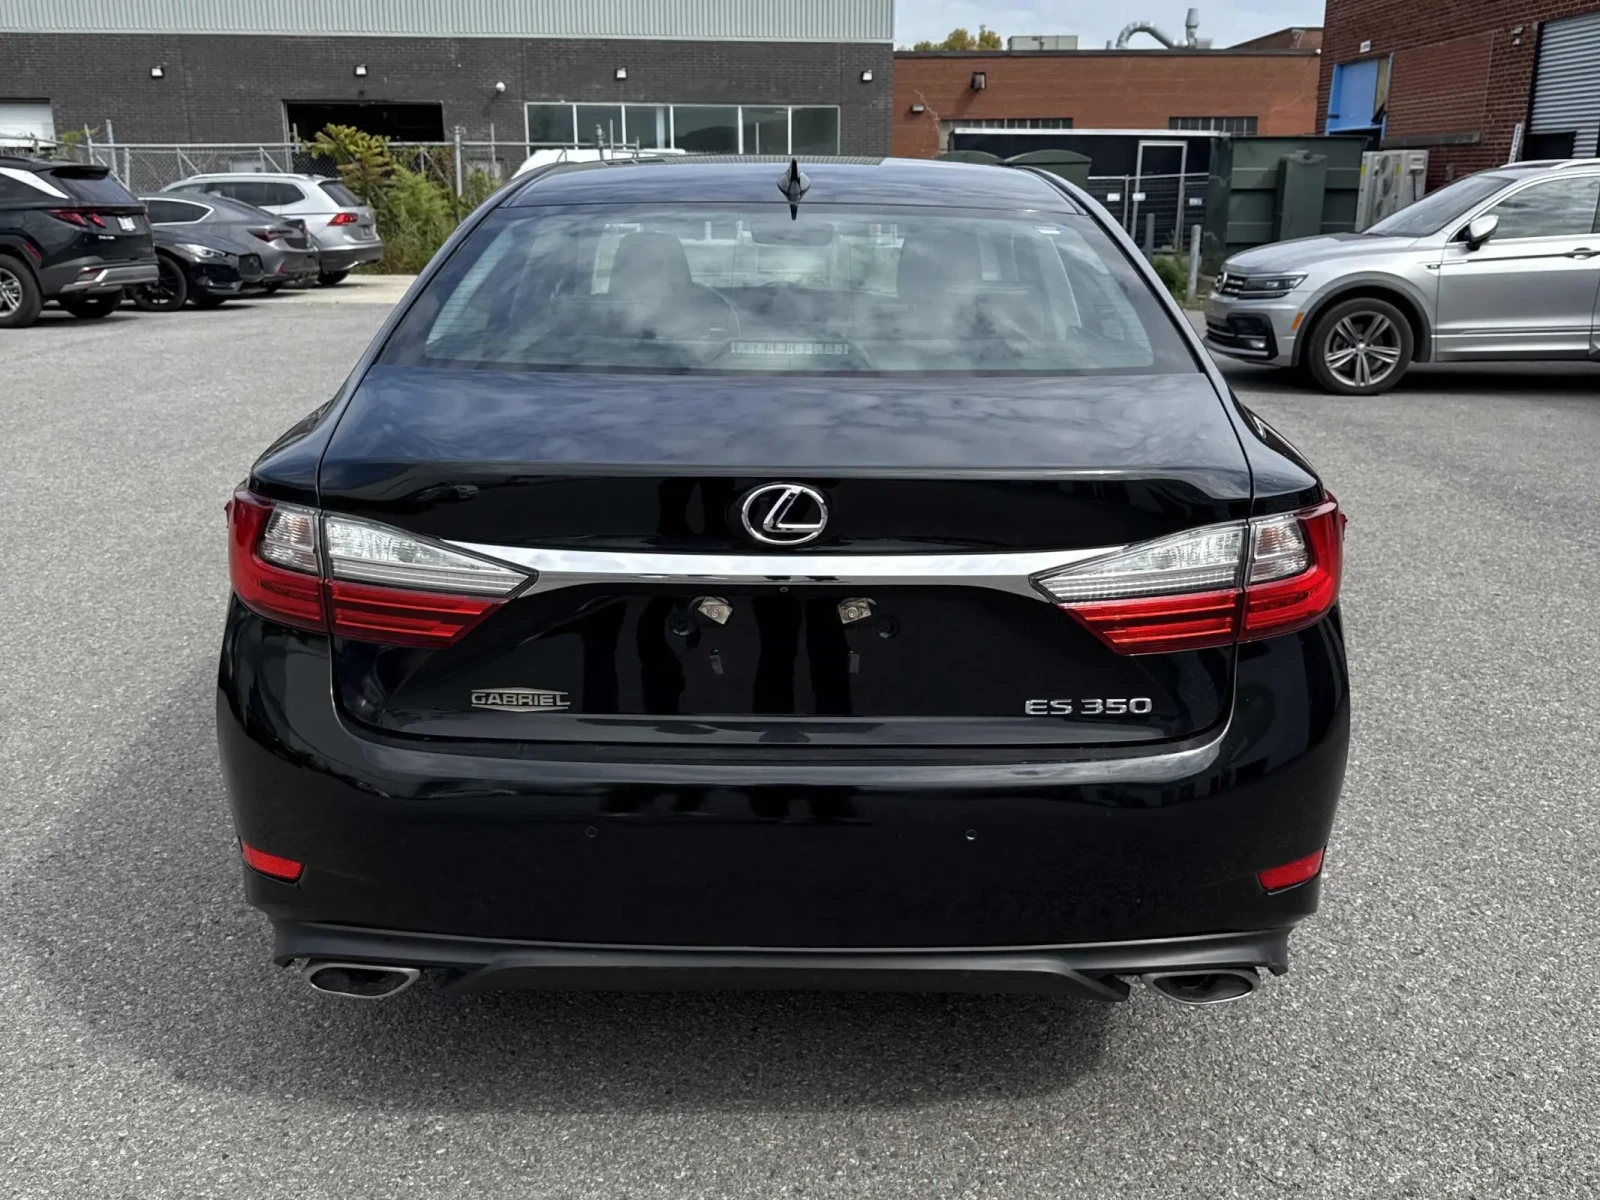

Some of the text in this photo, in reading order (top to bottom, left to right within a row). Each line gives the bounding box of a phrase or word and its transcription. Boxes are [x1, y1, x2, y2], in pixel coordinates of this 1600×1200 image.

[471, 692, 571, 706] GABRIEL
[1025, 698, 1152, 714] ES 350
